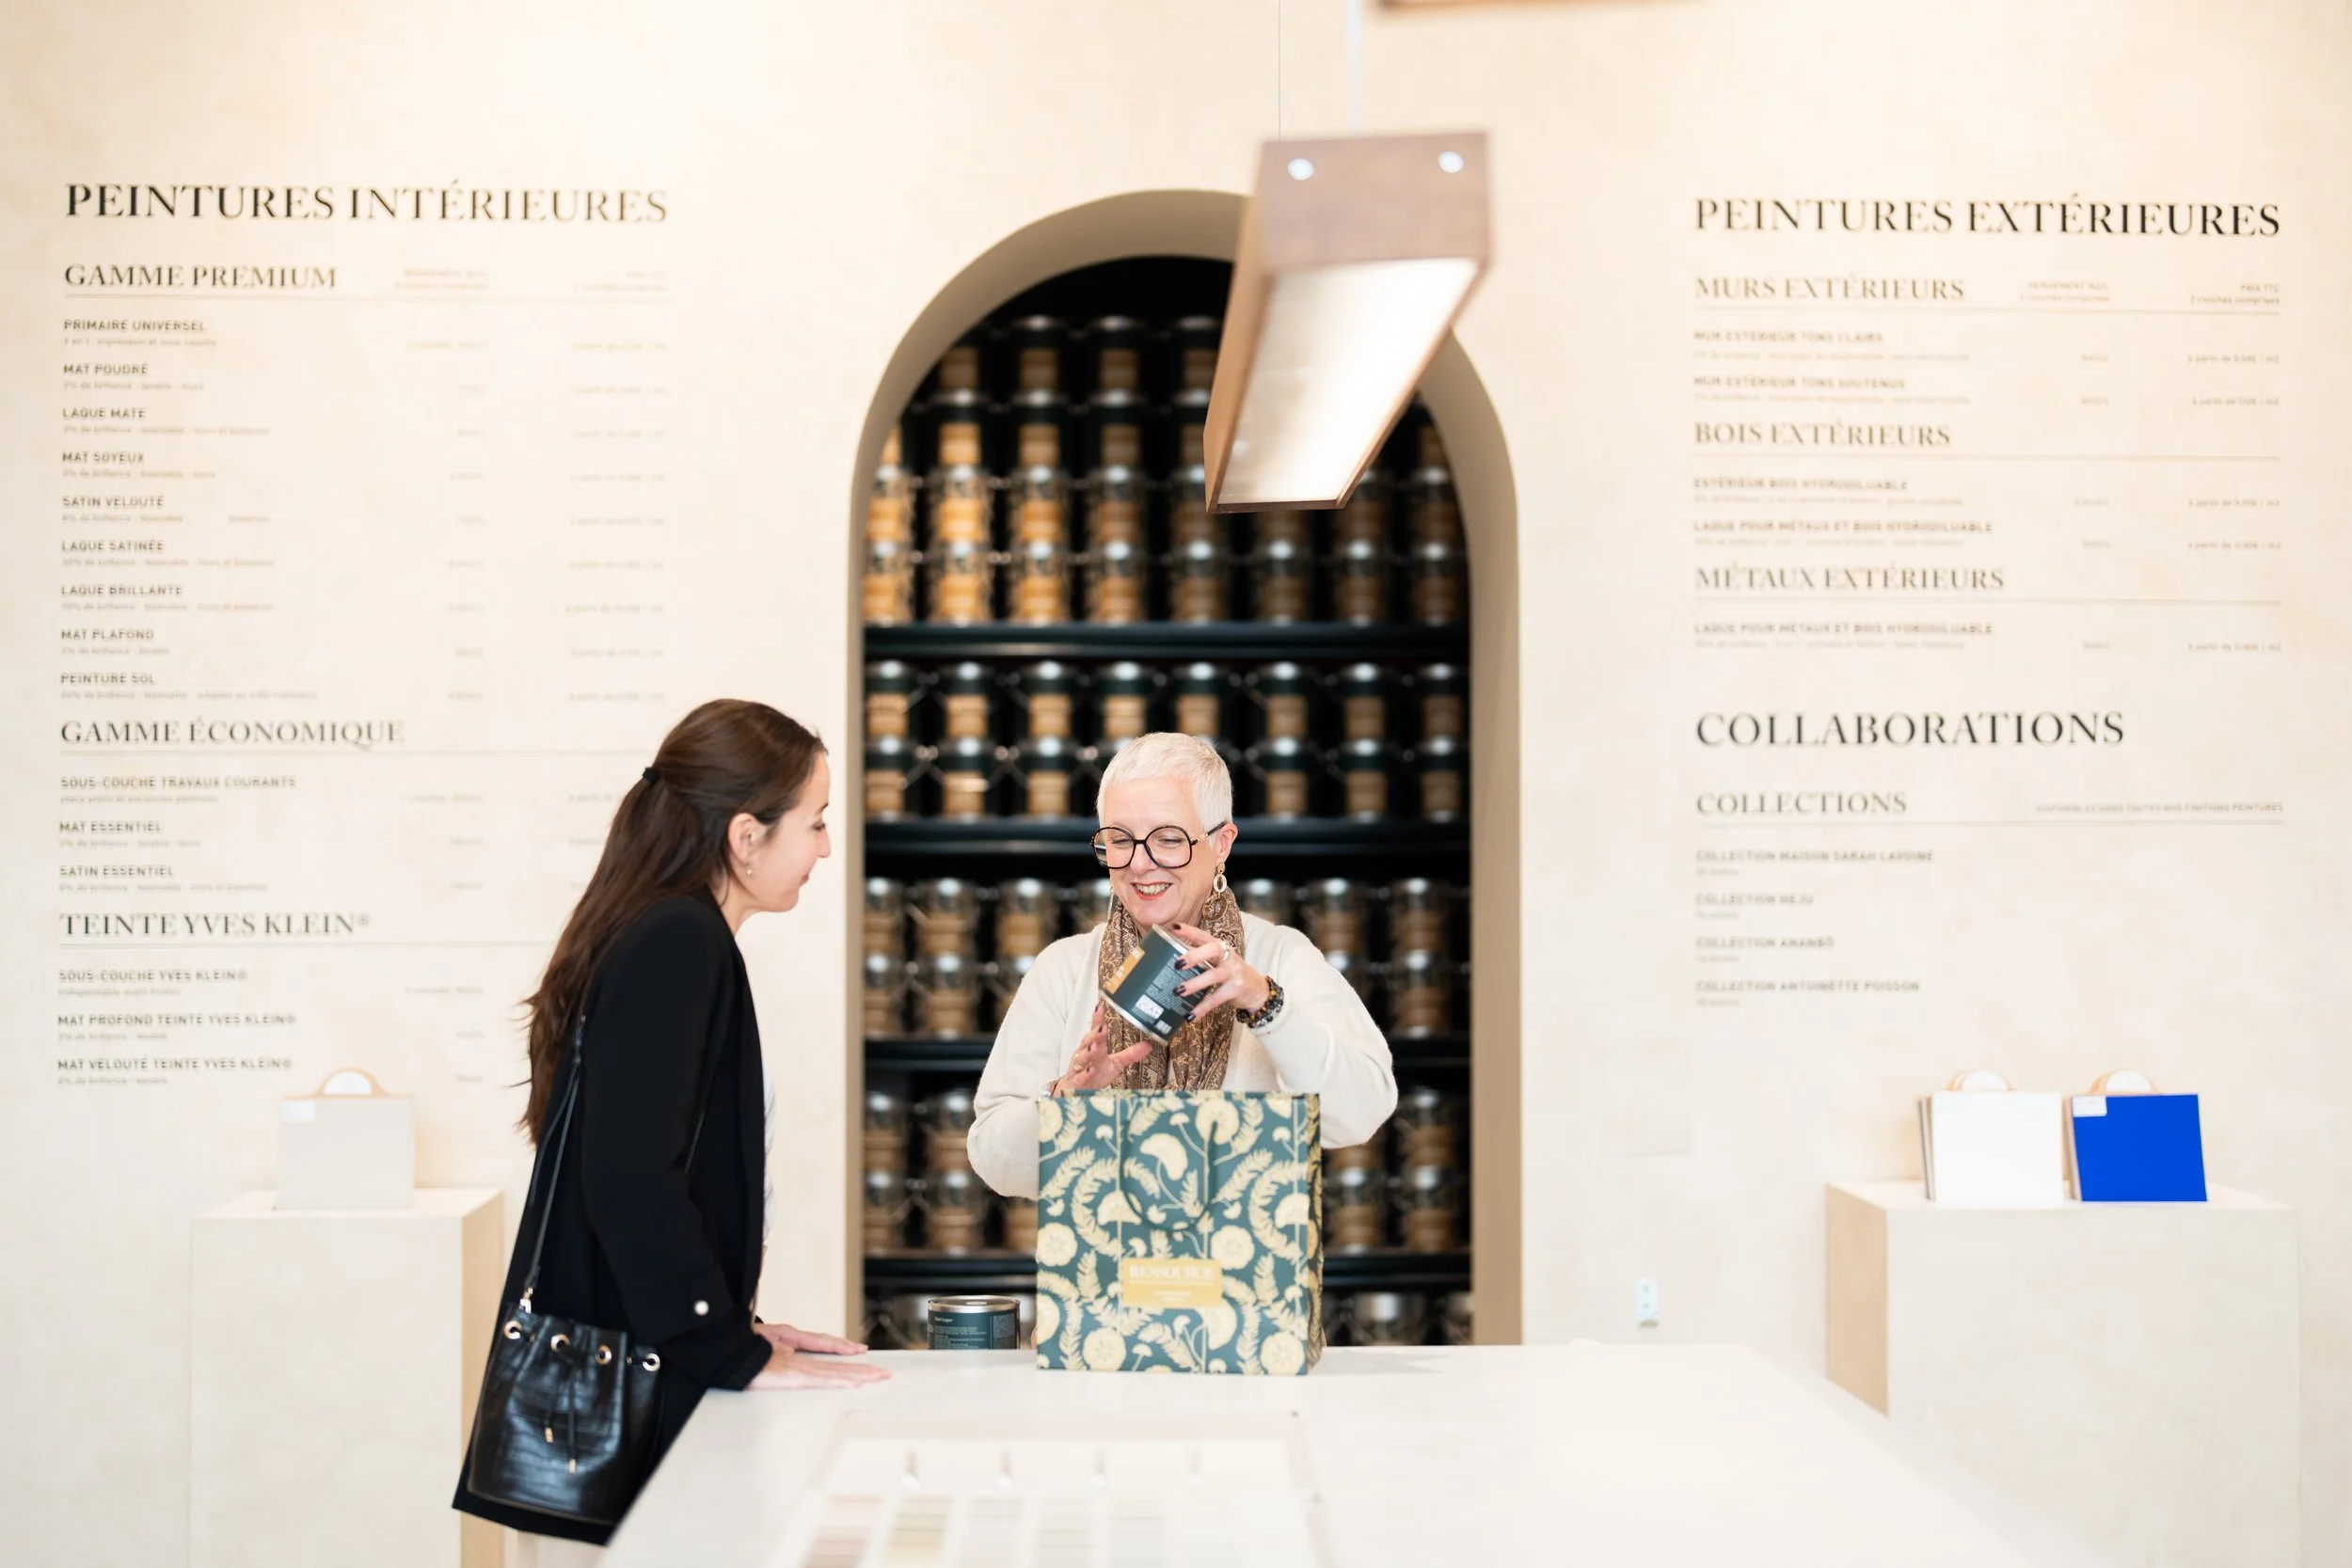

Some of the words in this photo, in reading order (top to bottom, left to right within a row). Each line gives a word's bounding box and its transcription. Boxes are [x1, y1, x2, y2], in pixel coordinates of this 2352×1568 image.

[63, 184, 336, 218] PEINTURES
[349, 181, 668, 220] INTÉRIEURES
[1694, 200, 1954, 230] PEINTURES
[1966, 193, 2281, 235] EXTÉRIEURES
[65, 265, 183, 286] GAMME
[193, 267, 335, 287] PREMIUM
[1696, 277, 1776, 298] MURS
[1785, 273, 1964, 299] EXTÉRIEURS
[64, 320, 127, 330] PRIMAIRE
[133, 321, 204, 332] UNIVERSEL
[63, 364, 88, 374] MAT
[95, 364, 147, 375] POUDRÉ
[62, 407, 105, 419] LAQUE
[110, 408, 145, 419] MATE
[1694, 423, 1762, 443] BOIS
[1771, 420, 1952, 446] EXTÉRIEURS
[62, 451, 87, 463] MAT
[93, 451, 143, 464] SOYEUX
[62, 496, 101, 508] SATIN
[105, 493, 164, 509] VELOUTÉ
[61, 541, 104, 553] LAQUE
[109, 540, 164, 552] SATINÉE
[1697, 562, 1814, 589] MÉTAUX
[1825, 562, 2004, 589] EXTÉRIEURS
[61, 584, 104, 596] LAQUE
[108, 585, 183, 596] BRILLANTE
[61, 629, 87, 640] MAT
[91, 629, 154, 641] PLAFOND
[60, 673, 126, 685] PEINTURE
[132, 673, 154, 685] SOL
[60, 721, 179, 743] GAMME
[189, 716, 405, 751] ÉCONOMIQUE
[1696, 714, 2123, 744] COLLABORATIONS
[162, 777, 220, 788] TRAVAUX
[224, 777, 295, 788] COURANTS
[1696, 793, 1906, 814] COLLECTIONS
[58, 821, 85, 832] MAT
[90, 821, 161, 833] ESSENTIEL
[60, 865, 98, 877] SATIN
[103, 865, 172, 878] ESSENTIEL
[59, 914, 177, 935] TEINTE
[184, 914, 256, 934] YVES
[159, 970, 192, 982] YVES
[57, 1015, 84, 1026] MAT
[88, 1014, 153, 1026] PROFOND
[157, 1014, 203, 1025] TEINTE
[209, 1014, 241, 1025] YVES
[57, 1059, 85, 1070] MAT
[88, 1058, 147, 1070] VELOUTÉ
[153, 1058, 199, 1069] TEINTE
[204, 1058, 236, 1069] YVES
